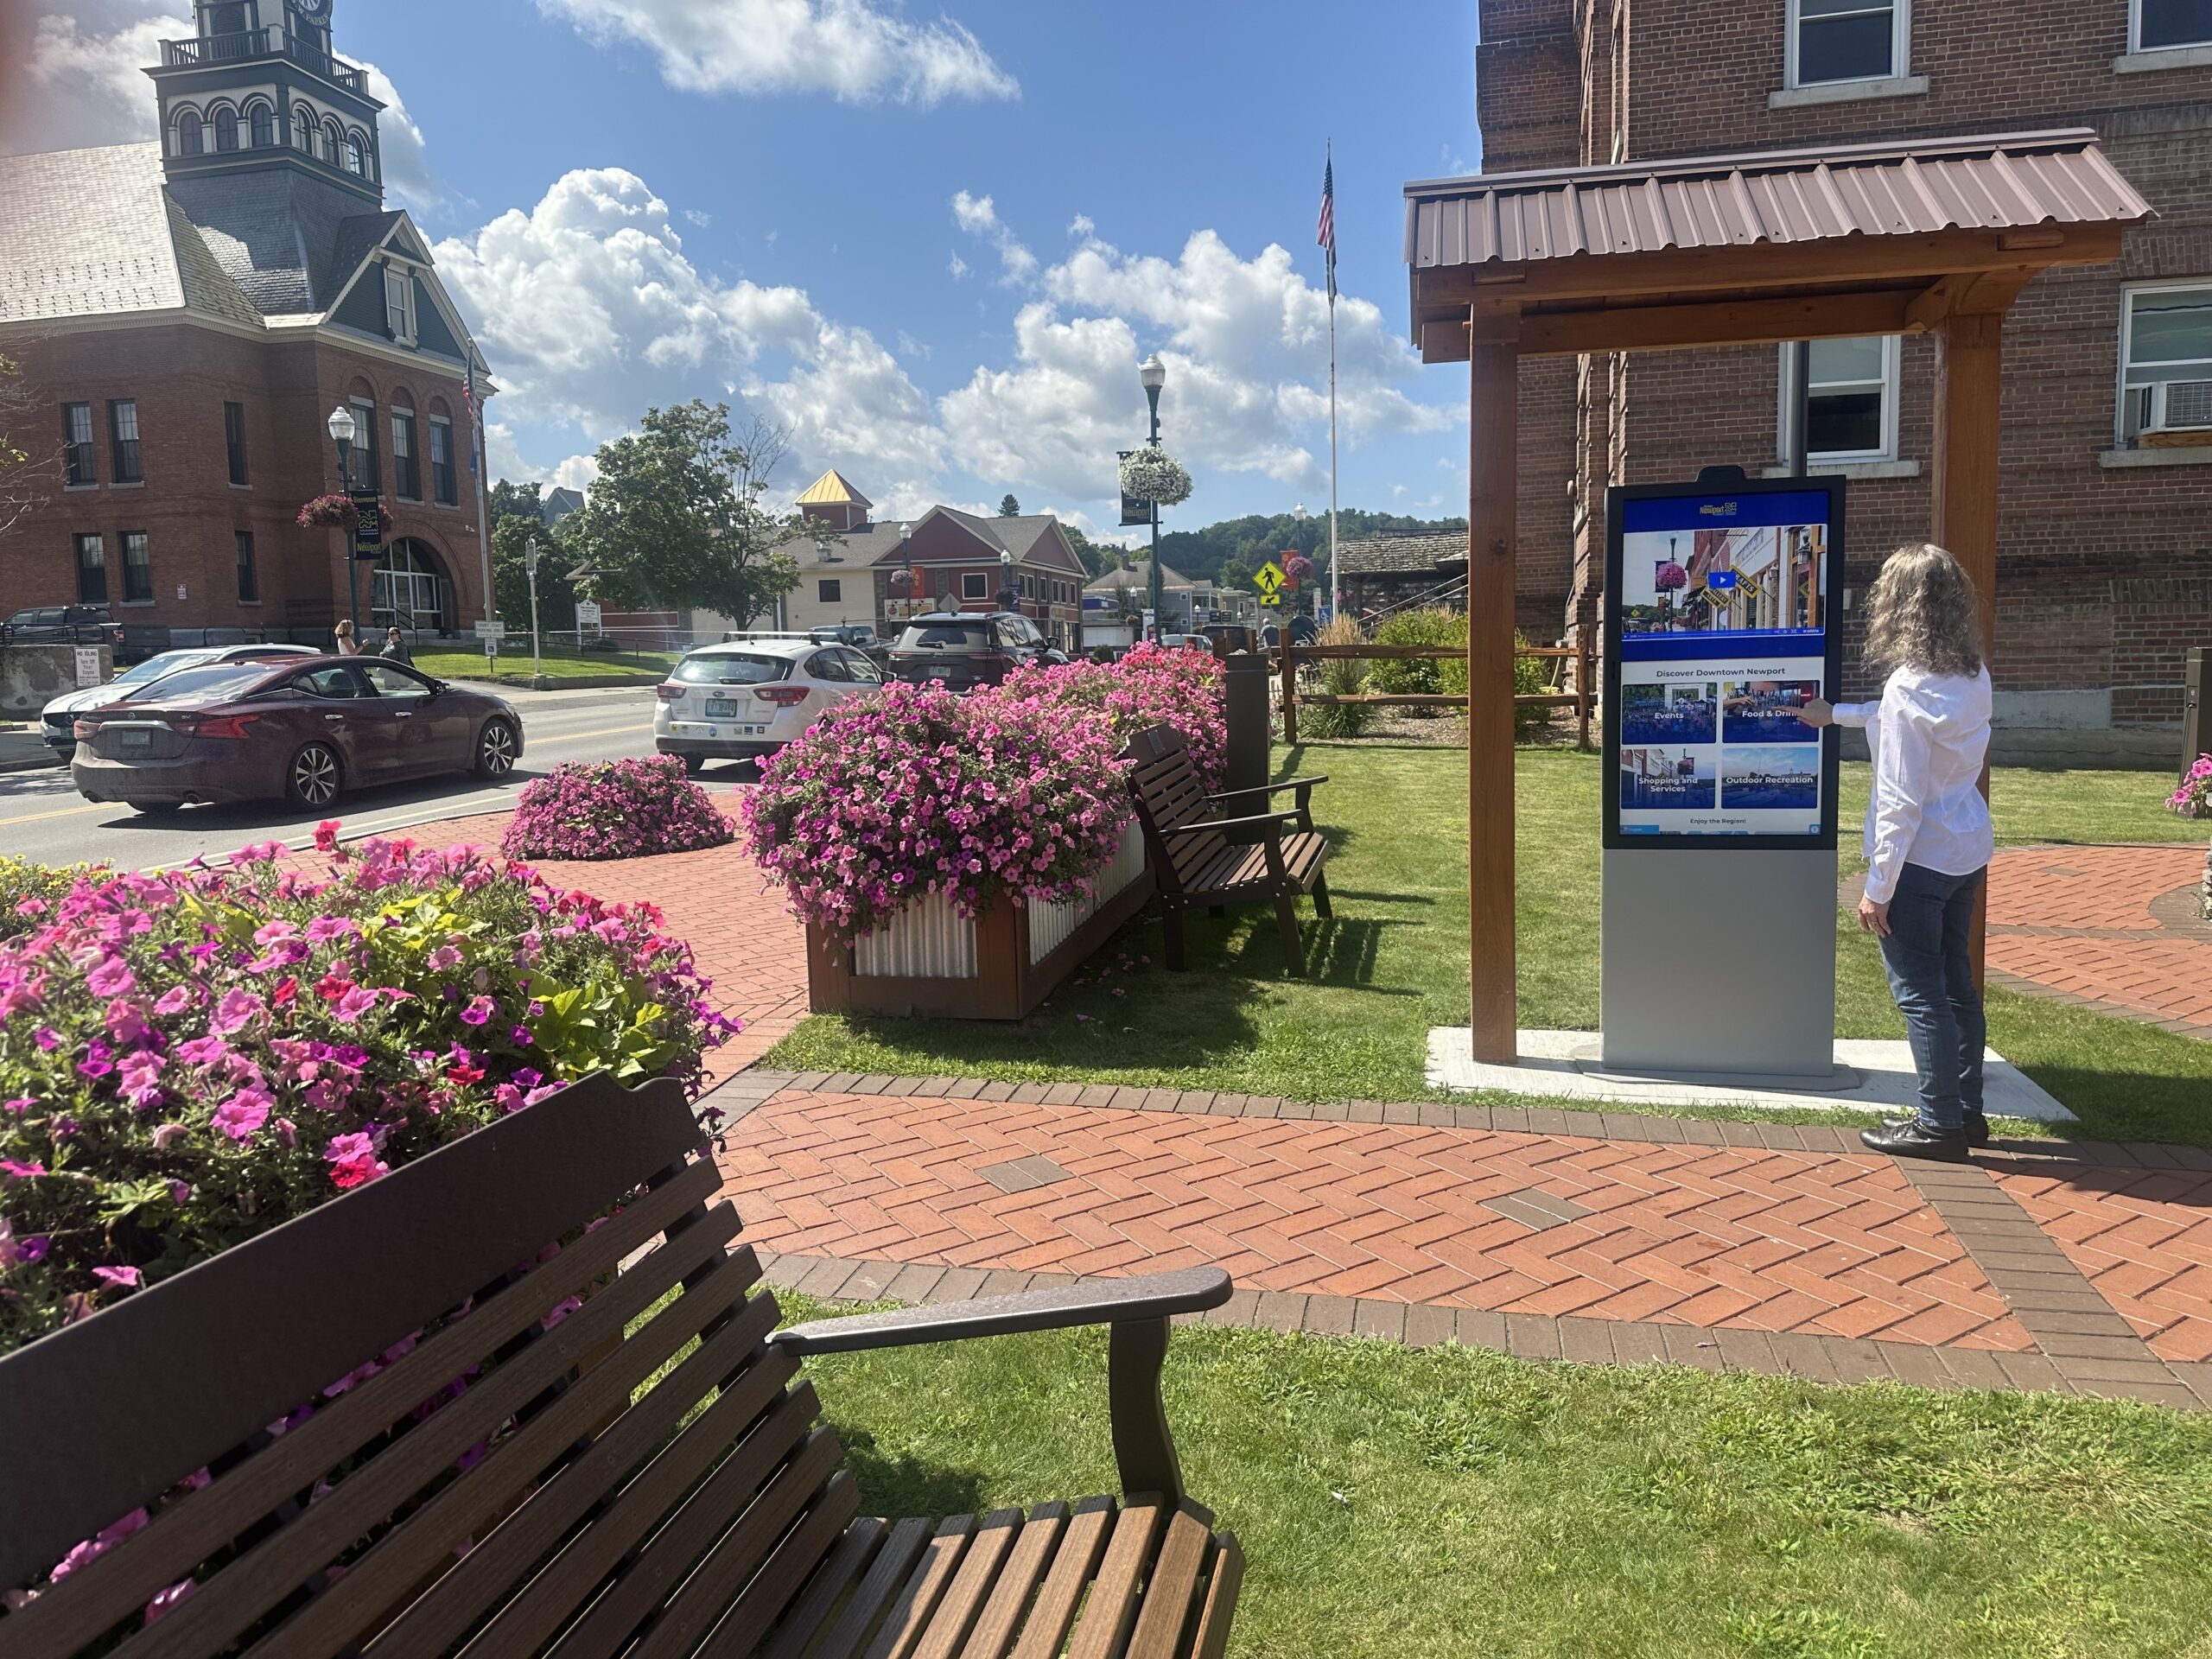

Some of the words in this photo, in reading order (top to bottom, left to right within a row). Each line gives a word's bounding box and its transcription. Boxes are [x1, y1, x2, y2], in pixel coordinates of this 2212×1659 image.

[306, 13, 329, 26] PARKER
[1123, 507, 1150, 518] Newport
[1700, 505, 1724, 516] Newport
[357, 543, 381, 553] Newport
[1638, 777, 1680, 785] Shopping
